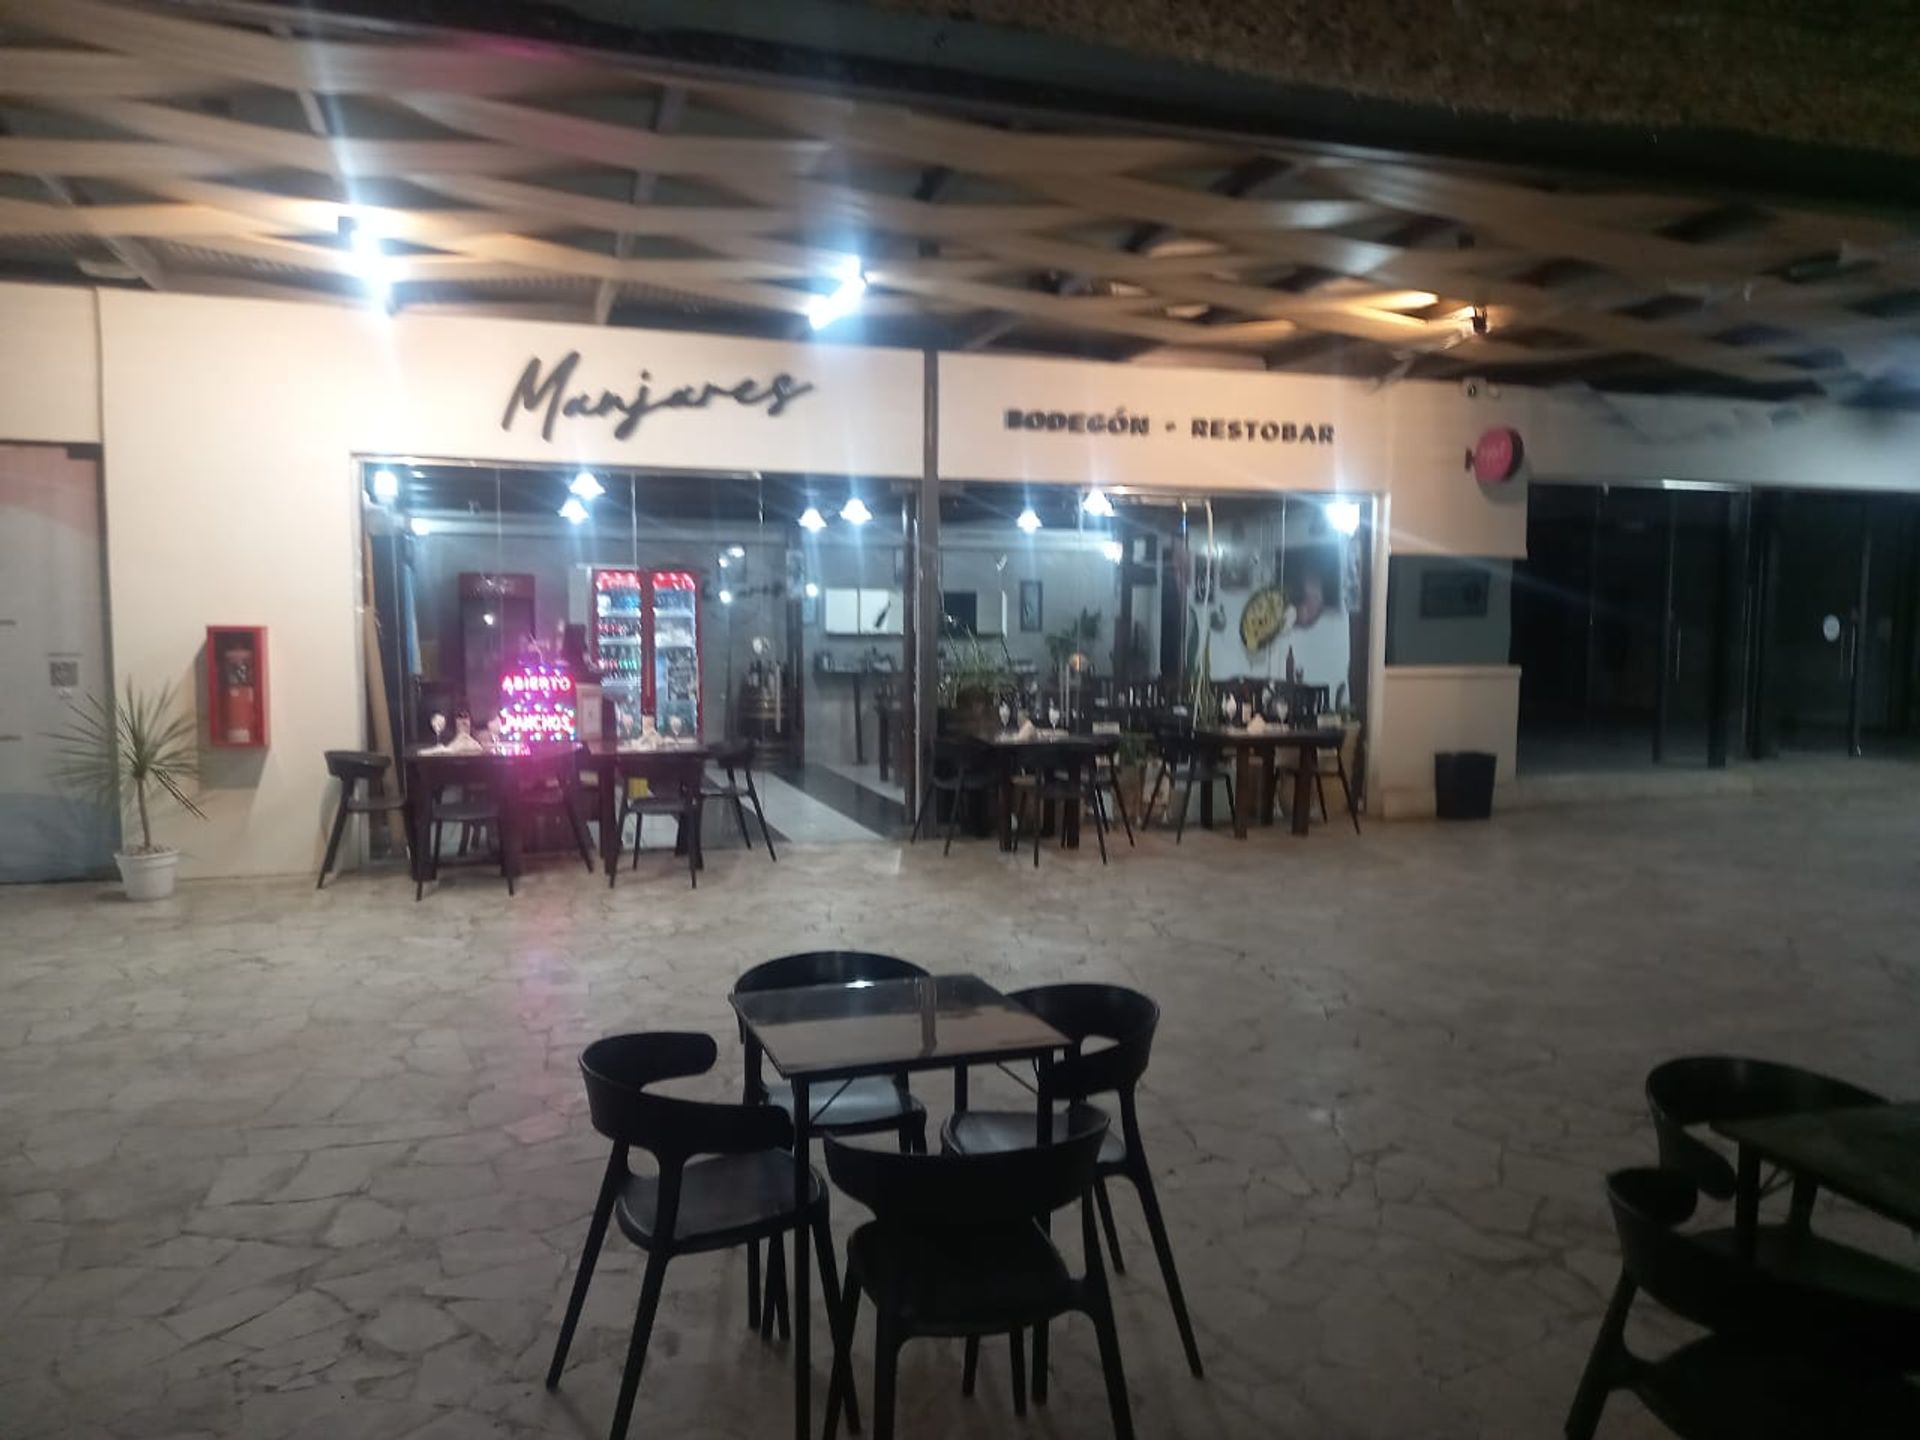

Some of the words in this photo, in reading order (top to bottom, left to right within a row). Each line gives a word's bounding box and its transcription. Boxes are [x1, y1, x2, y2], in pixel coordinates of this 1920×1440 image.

[501, 350, 813, 442] Manjares
[1004, 406, 1150, 435] BODEGÓN
[1191, 418, 1335, 444] RESTOBAR
[502, 675, 571, 692] ABIERTO
